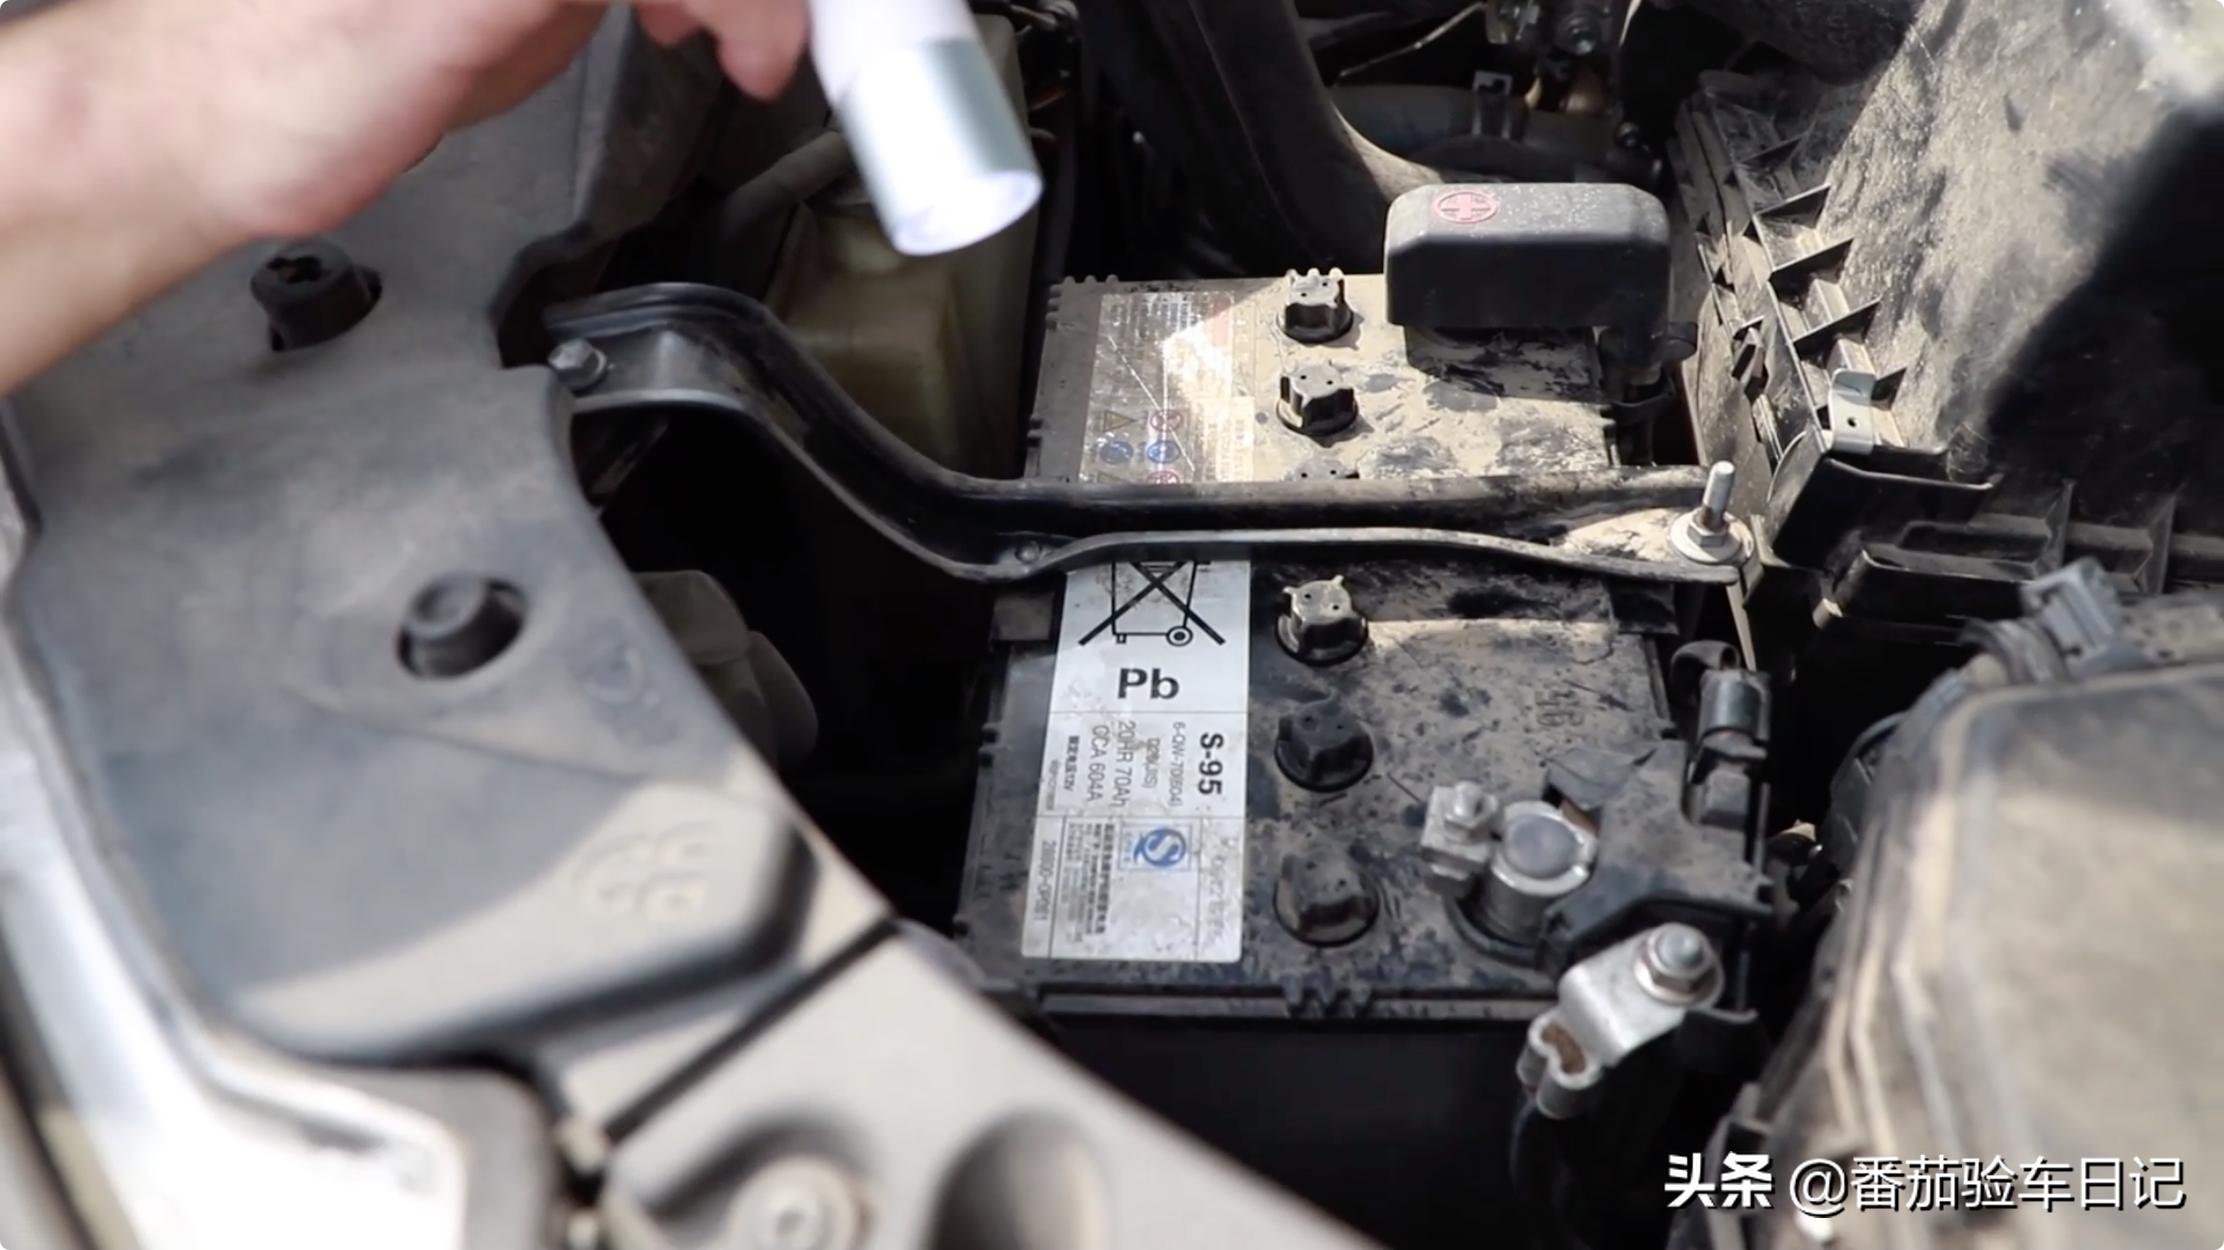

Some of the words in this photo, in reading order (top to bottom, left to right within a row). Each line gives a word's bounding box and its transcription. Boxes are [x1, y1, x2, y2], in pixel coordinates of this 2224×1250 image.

[1117, 668, 1180, 700] Pb
[1091, 724, 1110, 759] CCA
[1115, 720, 1136, 763] 20HR
[1086, 762, 1106, 803] 604A
[1198, 732, 1225, 795] S-95
[1109, 766, 1133, 808] 70Ah
